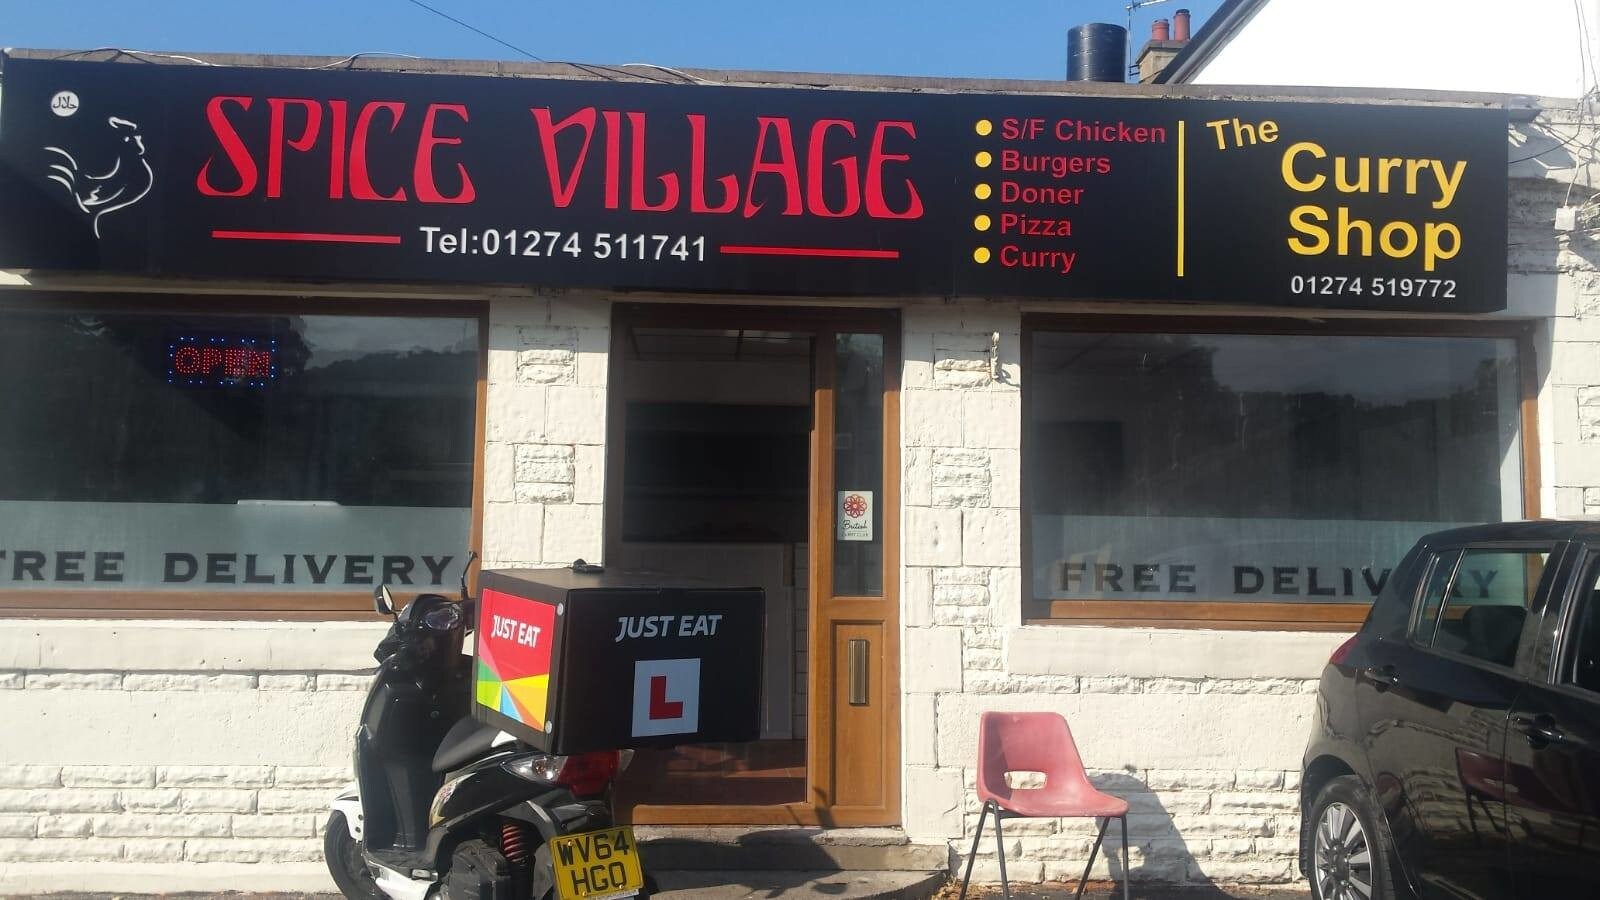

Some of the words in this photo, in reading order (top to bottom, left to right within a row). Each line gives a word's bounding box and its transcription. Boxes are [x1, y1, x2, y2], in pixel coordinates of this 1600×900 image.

[1001, 118, 1045, 140] S/F
[1055, 119, 1166, 143] Chicken
[1206, 118, 1279, 150] The
[196, 96, 477, 204] SPICE
[530, 107, 924, 219] VILLAGE
[1001, 149, 1111, 178] Burgers
[1000, 181, 1084, 204] Doner
[1281, 142, 1467, 209] Curry
[1000, 213, 1072, 236] Pizza
[1287, 205, 1462, 271] Shop
[419, 226, 582, 257] Tel:01274
[593, 233, 705, 261] 511741
[999, 245, 1076, 274] Curry
[1290, 275, 1363, 295] 01274
[1371, 277, 1457, 298] 519772
[175, 346, 270, 376] OPEN
[0, 550, 125, 582] REE
[163, 552, 454, 585] DELIVERY
[1060, 562, 1197, 593] FREE
[1232, 565, 1499, 598] DELIVY
[491, 614, 517, 641] JUST
[517, 622, 542, 648] EAT
[615, 615, 674, 642] JUST
[678, 614, 722, 637] EAT
[649, 675, 683, 720] L
[557, 831, 630, 866] WV64
[571, 861, 628, 895] HGO
